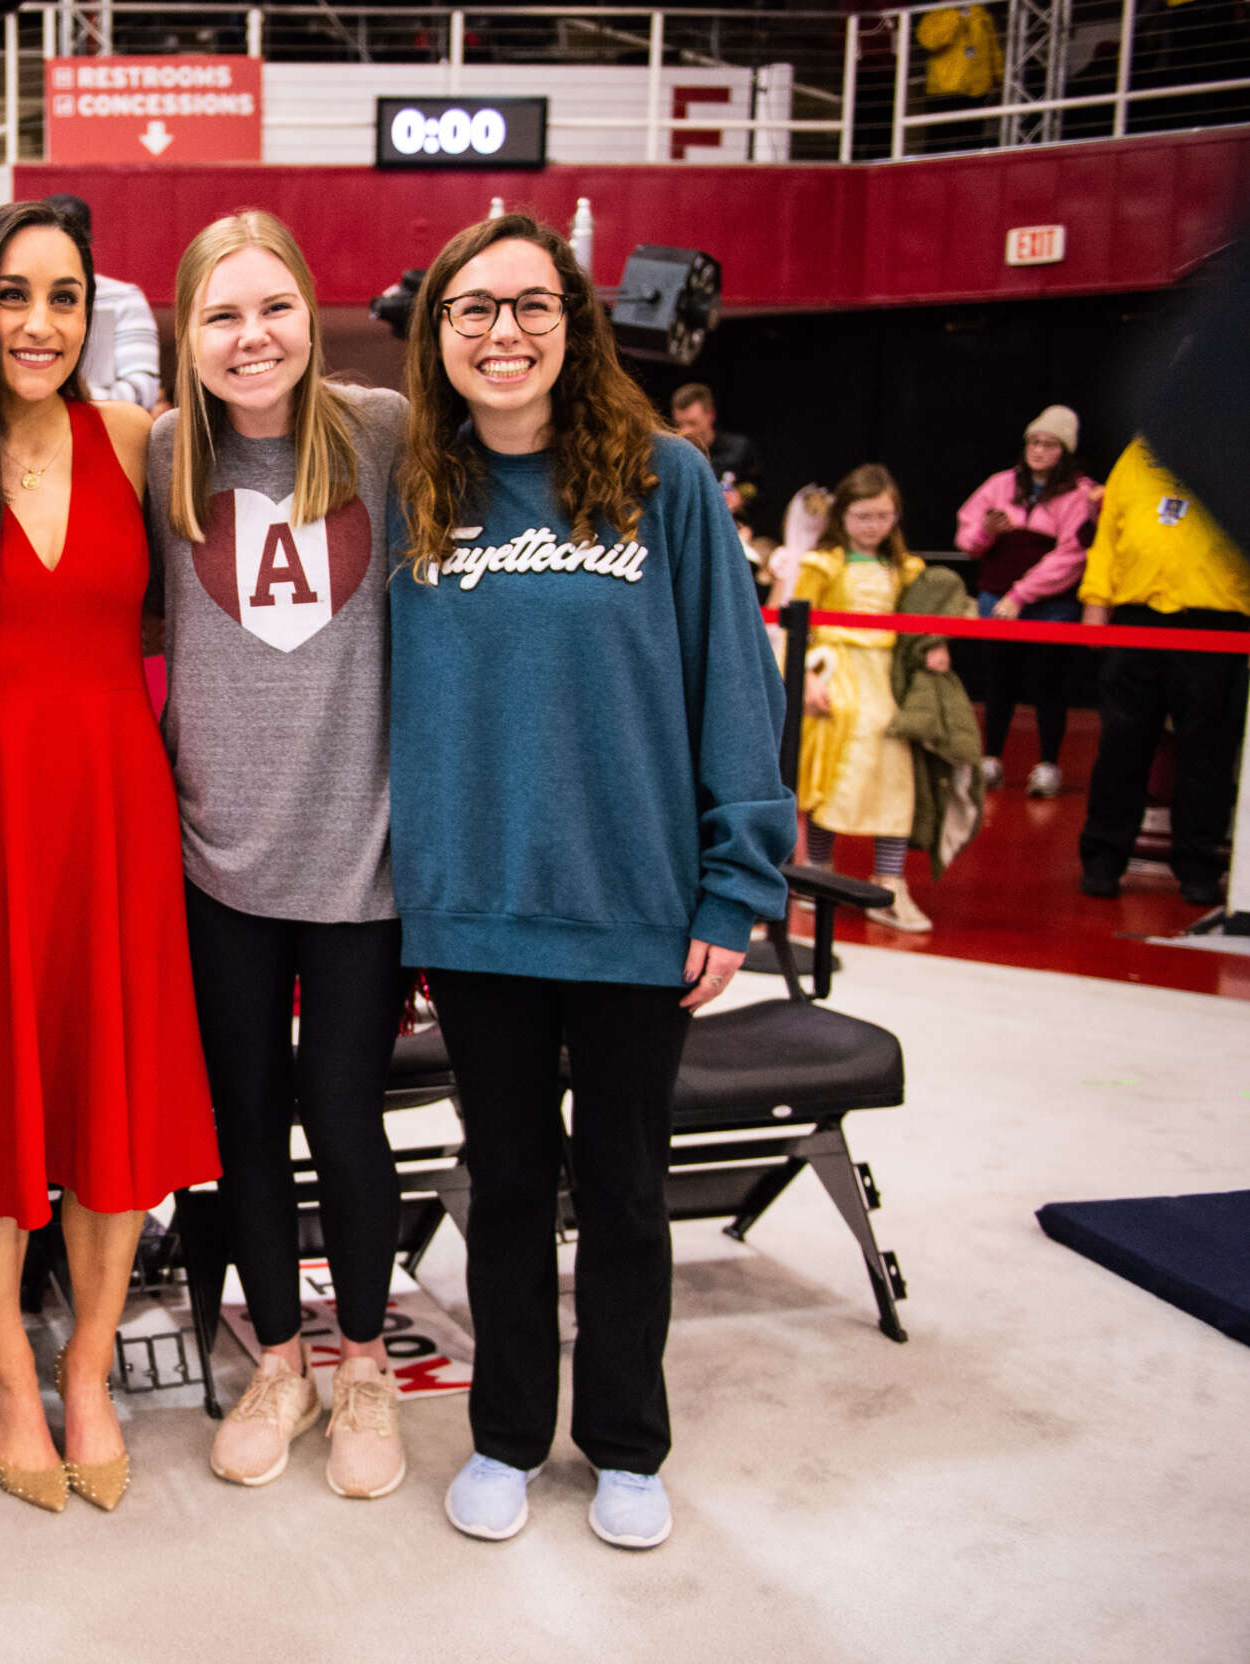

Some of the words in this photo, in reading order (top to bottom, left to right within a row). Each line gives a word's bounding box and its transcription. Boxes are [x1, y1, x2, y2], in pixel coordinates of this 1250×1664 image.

[77, 66, 232, 89] RESTROOMS
[77, 93, 254, 117] CONCESSIONS
[391, 106, 507, 155] 0:00
[1016, 228, 1055, 259] EXIT
[249, 522, 318, 607] A
